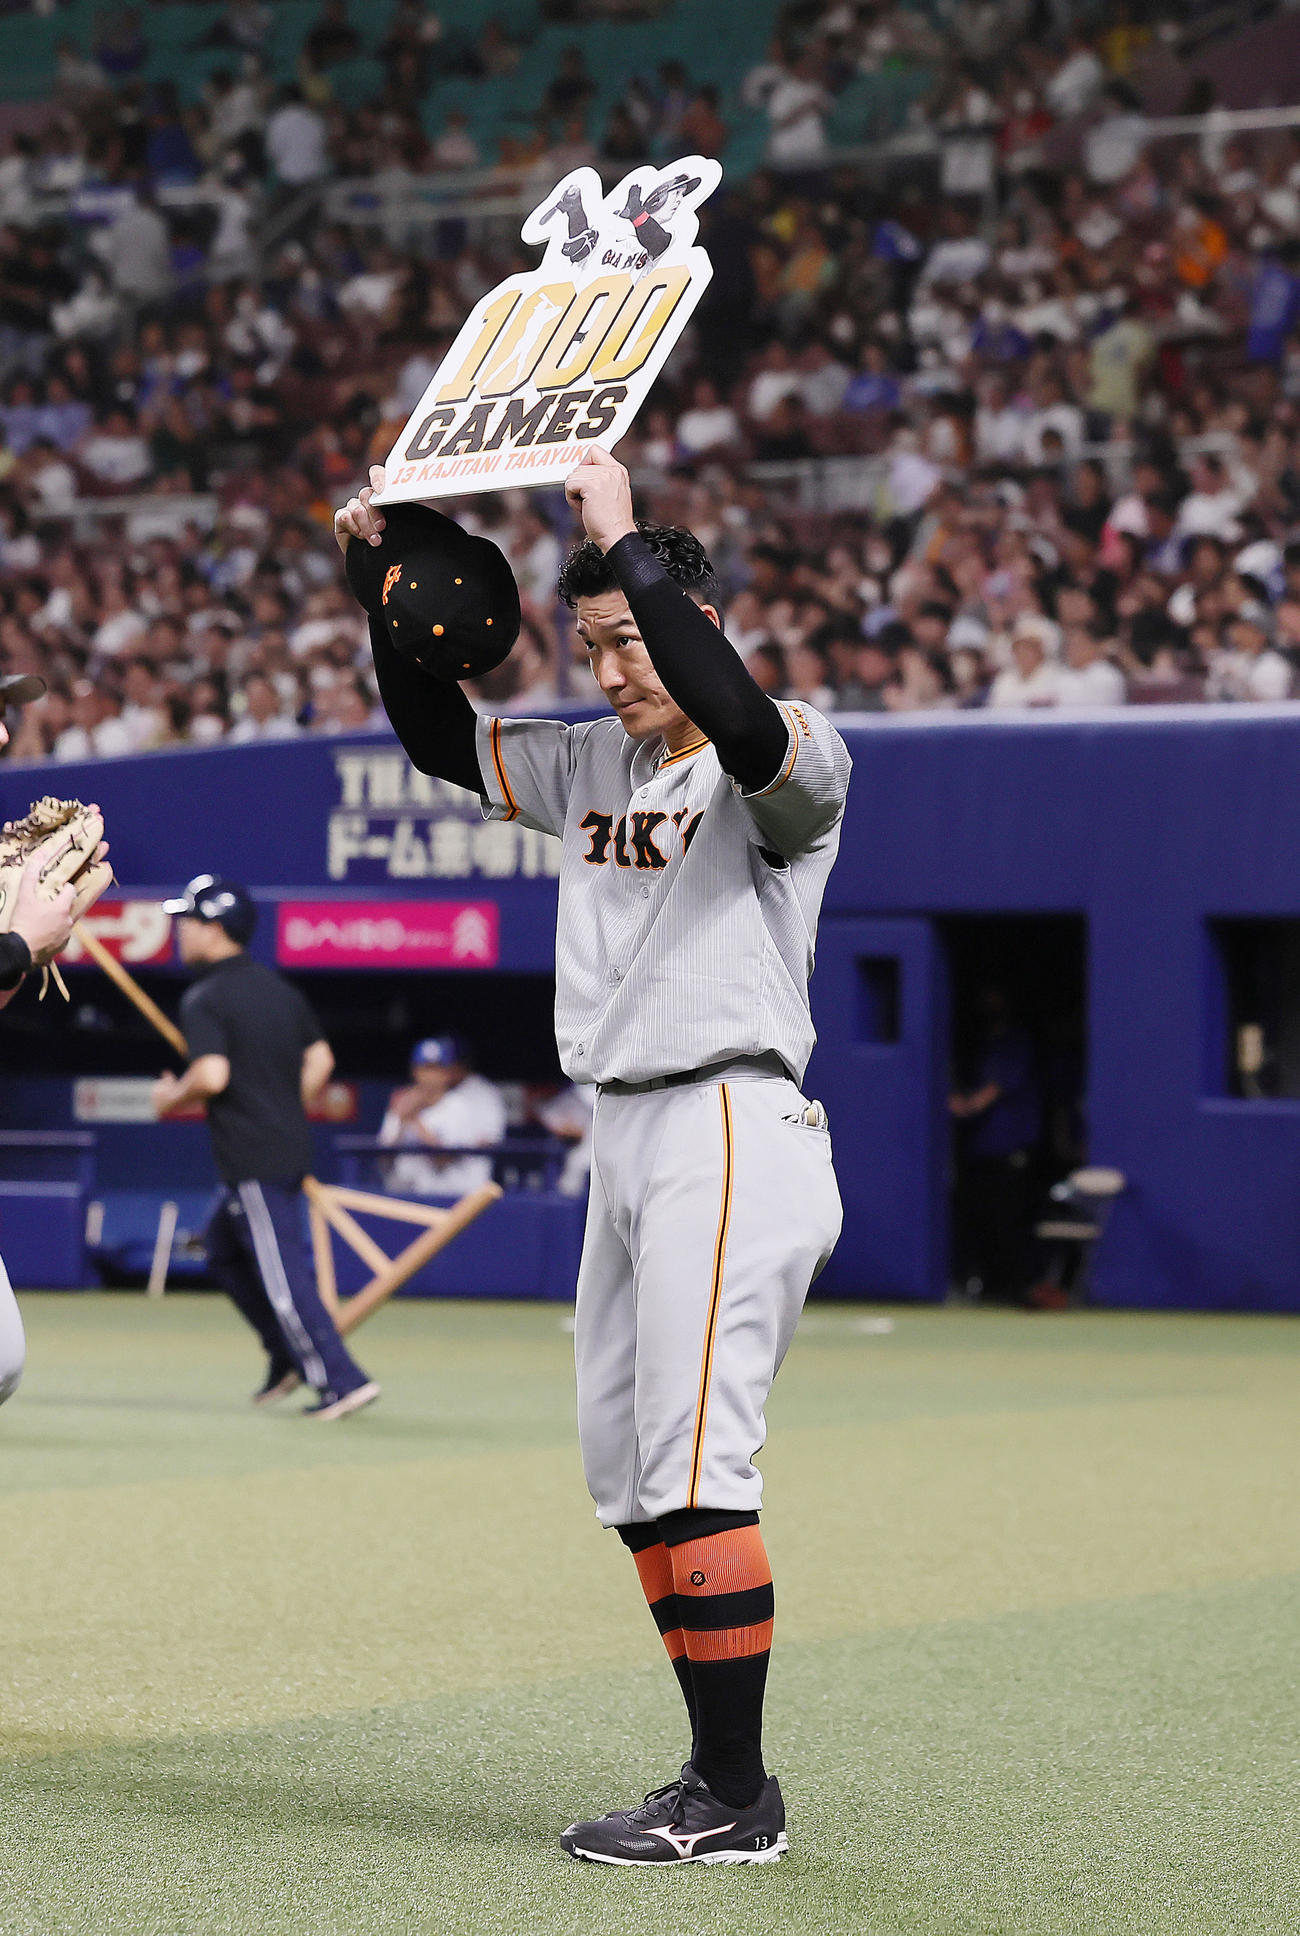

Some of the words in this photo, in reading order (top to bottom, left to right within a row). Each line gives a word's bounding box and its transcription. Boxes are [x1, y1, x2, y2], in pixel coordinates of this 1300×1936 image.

[434, 264, 692, 406] 1000
[405, 386, 628, 461] GAMES
[392, 465, 417, 485] 13
[417, 455, 500, 482] KAJITANI
[505, 444, 590, 471] TAKAYUK
[754, 1836, 768, 1850] 13
